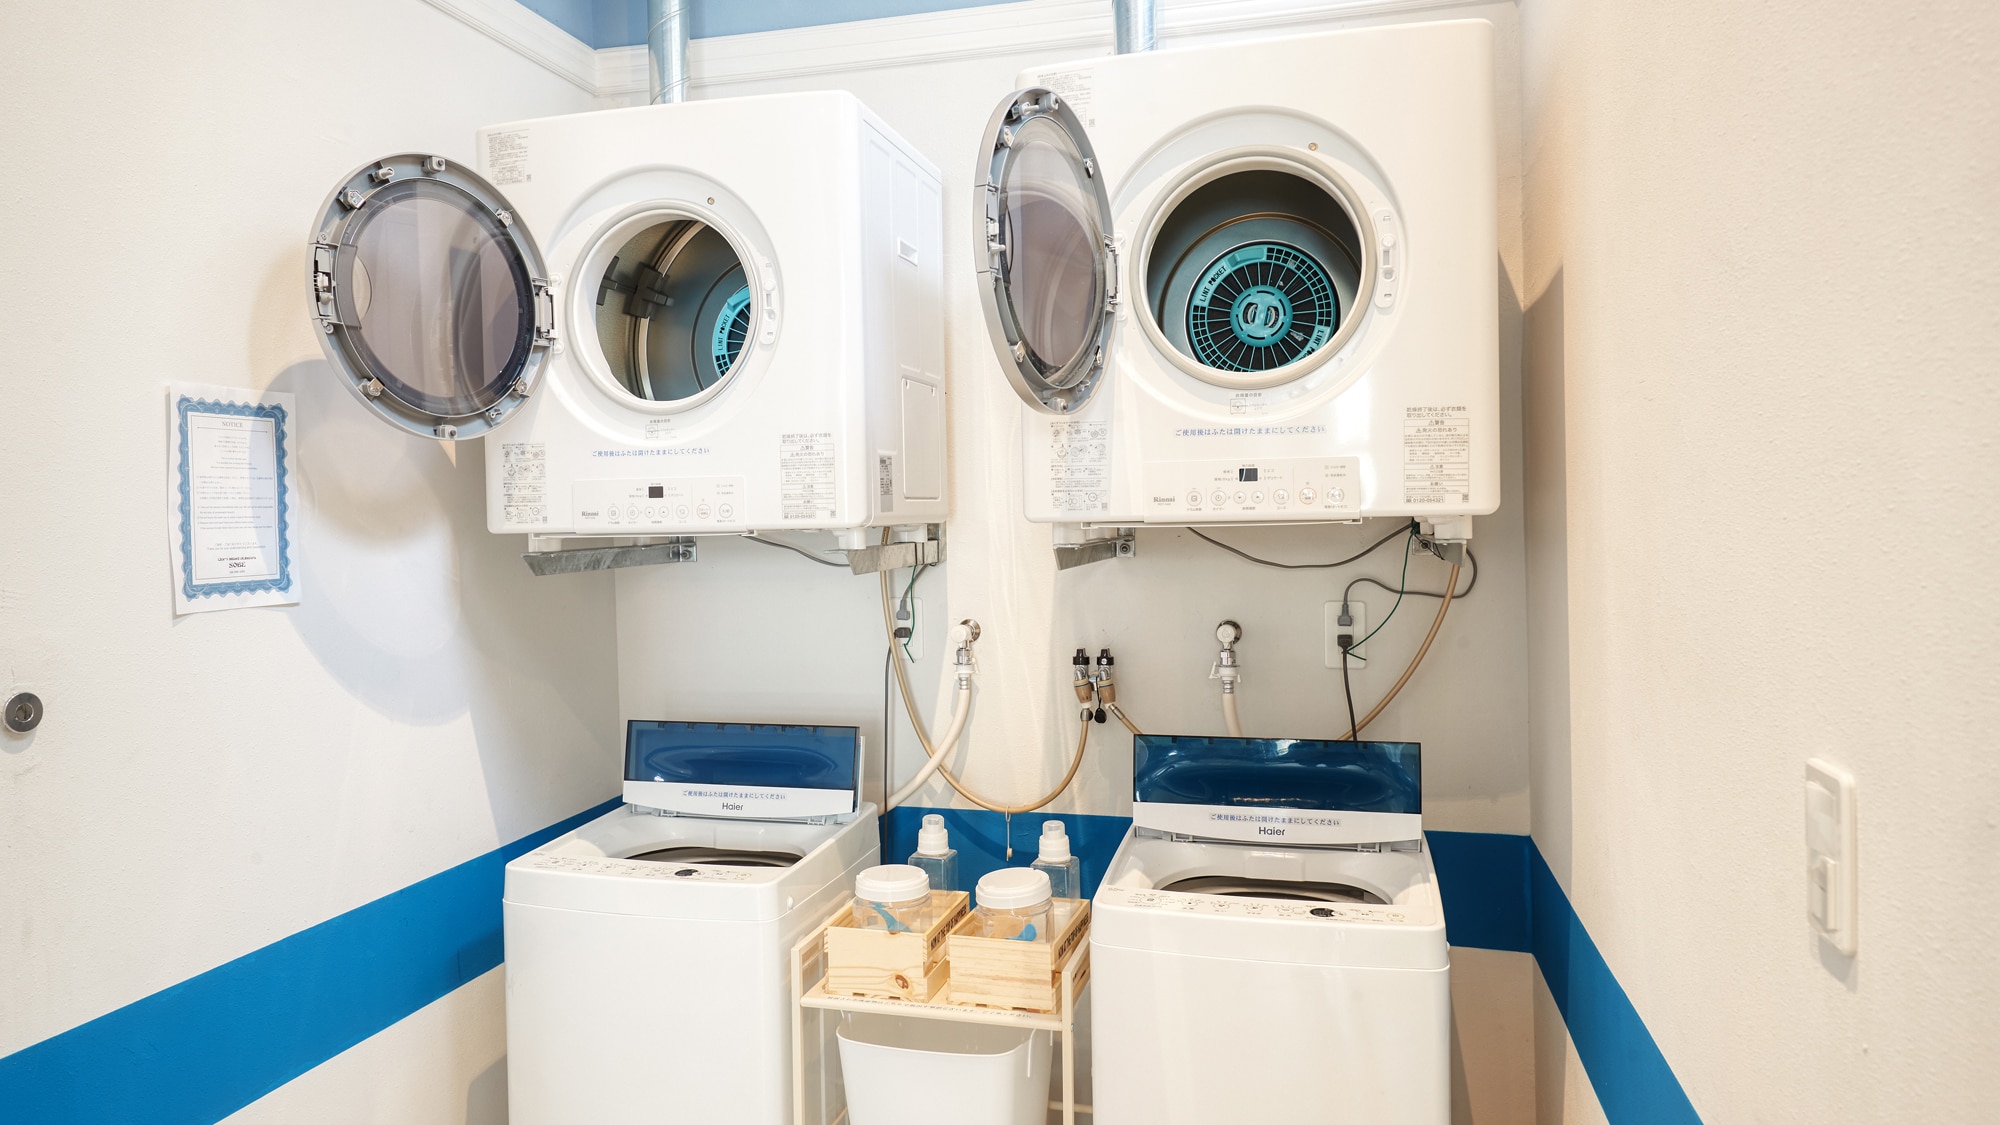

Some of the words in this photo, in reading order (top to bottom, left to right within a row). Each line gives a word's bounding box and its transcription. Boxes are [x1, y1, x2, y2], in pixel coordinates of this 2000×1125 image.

[1199, 286, 1210, 303] LINT
[1208, 265, 1228, 285] POCKET
[719, 315, 730, 334] POCKET
[1313, 329, 1325, 346] LINT
[1175, 426, 1325, 437] ご使用後はふたは開けたままにしてください
[592, 448, 710, 457] ご使用後はふたは開けたままにしてください
[682, 790, 786, 800] ご使用後はふたは開けたままにしてください
[721, 802, 744, 811] Haier
[1210, 813, 1340, 826] ご使用後はふたは開けたままにしてください
[1258, 826, 1286, 837] Haier
